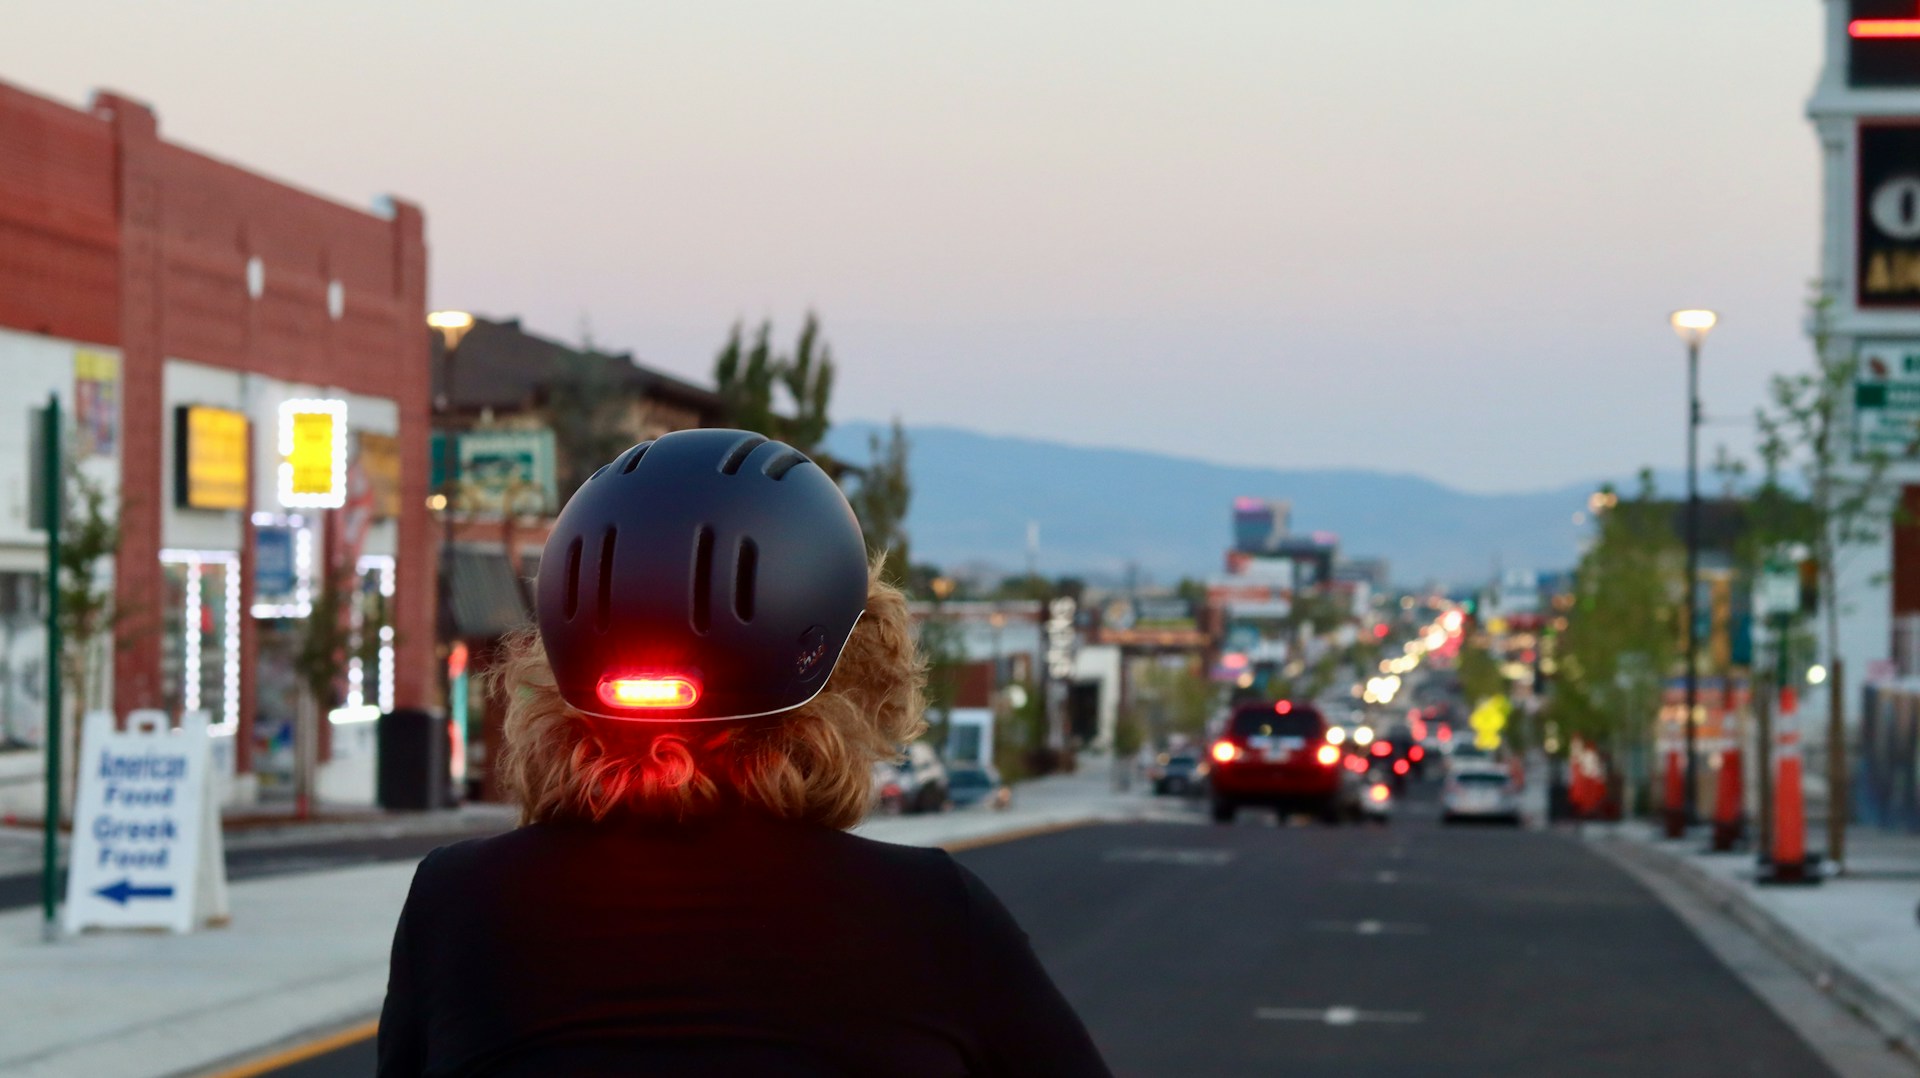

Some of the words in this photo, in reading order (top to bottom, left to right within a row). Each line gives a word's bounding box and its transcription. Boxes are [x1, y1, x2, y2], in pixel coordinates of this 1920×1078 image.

[99, 750, 187, 780] American
[104, 783, 174, 807] Food
[93, 815, 178, 841] Greek
[99, 847, 169, 870] Food
